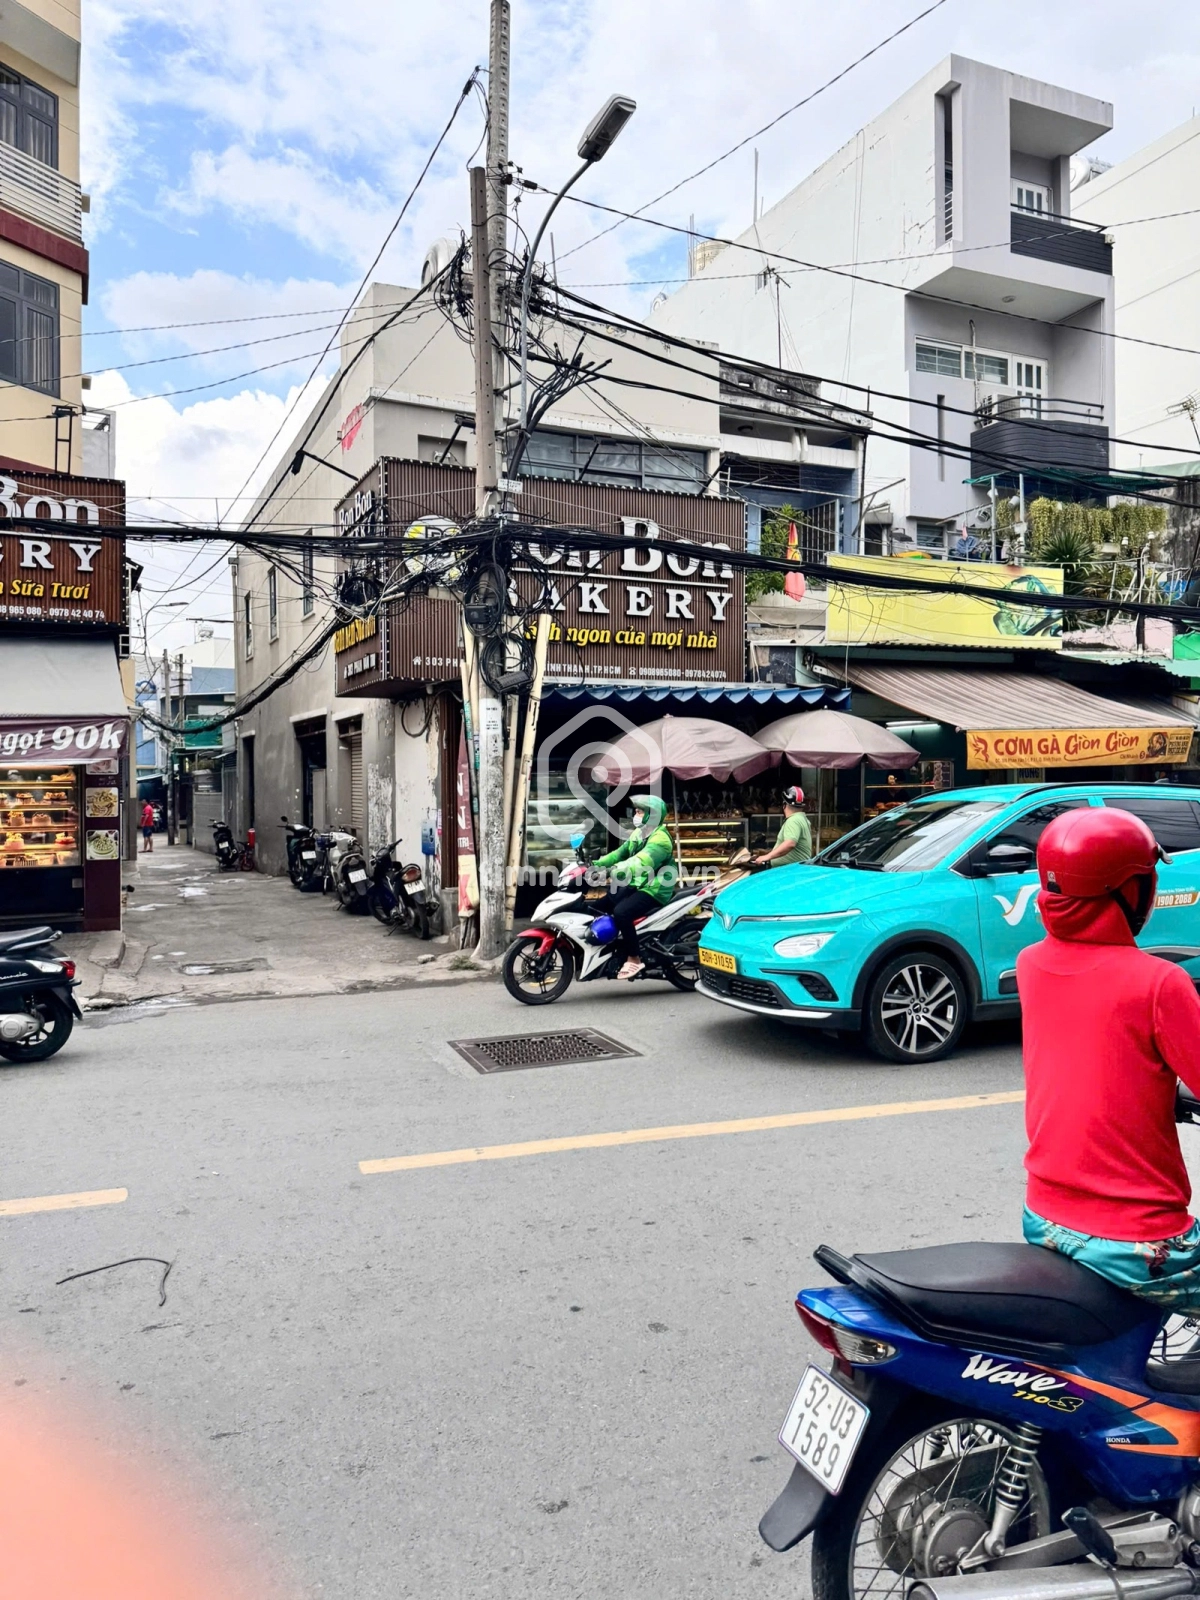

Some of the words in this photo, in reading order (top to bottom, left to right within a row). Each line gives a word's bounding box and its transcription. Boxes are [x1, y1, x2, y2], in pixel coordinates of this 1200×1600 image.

[0, 540, 101, 571] RY
[620, 516, 734, 579] Bon
[10, 579, 44, 597] Sữa
[51, 583, 91, 599] Tươi
[508, 573, 733, 621] AKERY
[566, 627, 611, 647] ngon
[615, 625, 646, 645] của
[651, 627, 683, 649] mọi
[687, 628, 718, 649] nhà
[425, 656, 443, 667] 303
[546, 661, 561, 672] ÌNH
[0, 729, 46, 756] gọt
[993, 736, 1034, 756] CƠM
[1037, 734, 1061, 755] GÀ
[1064, 733, 1101, 756] Giòn
[1105, 731, 1140, 752] Giòn
[1157, 896, 1174, 907] 1900
[961, 1354, 1069, 1391] Wave
[791, 1412, 841, 1478] 1589
